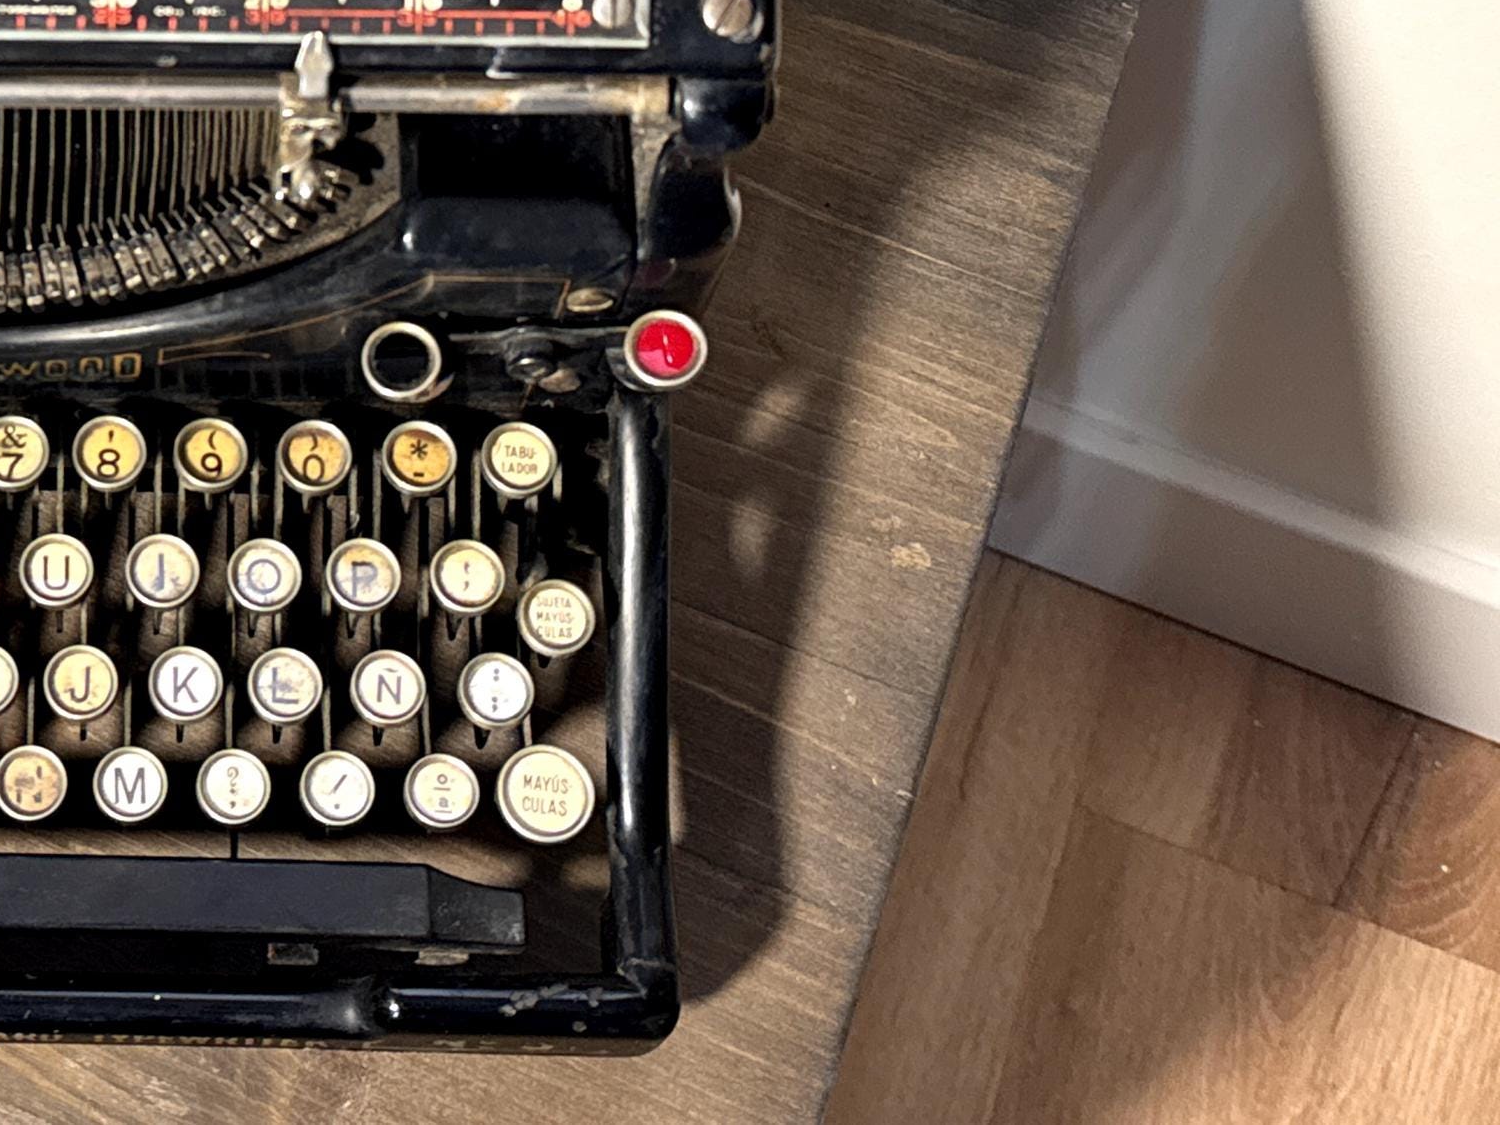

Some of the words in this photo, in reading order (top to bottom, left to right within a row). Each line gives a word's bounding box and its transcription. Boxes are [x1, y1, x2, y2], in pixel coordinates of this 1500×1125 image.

[0, 452, 25, 479] 7
[97, 448, 121, 478] 8
[200, 452, 223, 477] 9
[42, 555, 70, 591] U
[247, 558, 282, 595] O
[350, 560, 379, 598] P
[64, 665, 92, 704] J
[172, 666, 200, 704] K
[270, 666, 300, 705] L
[113, 766, 148, 805] M
[522, 795, 568, 817] CULAS
